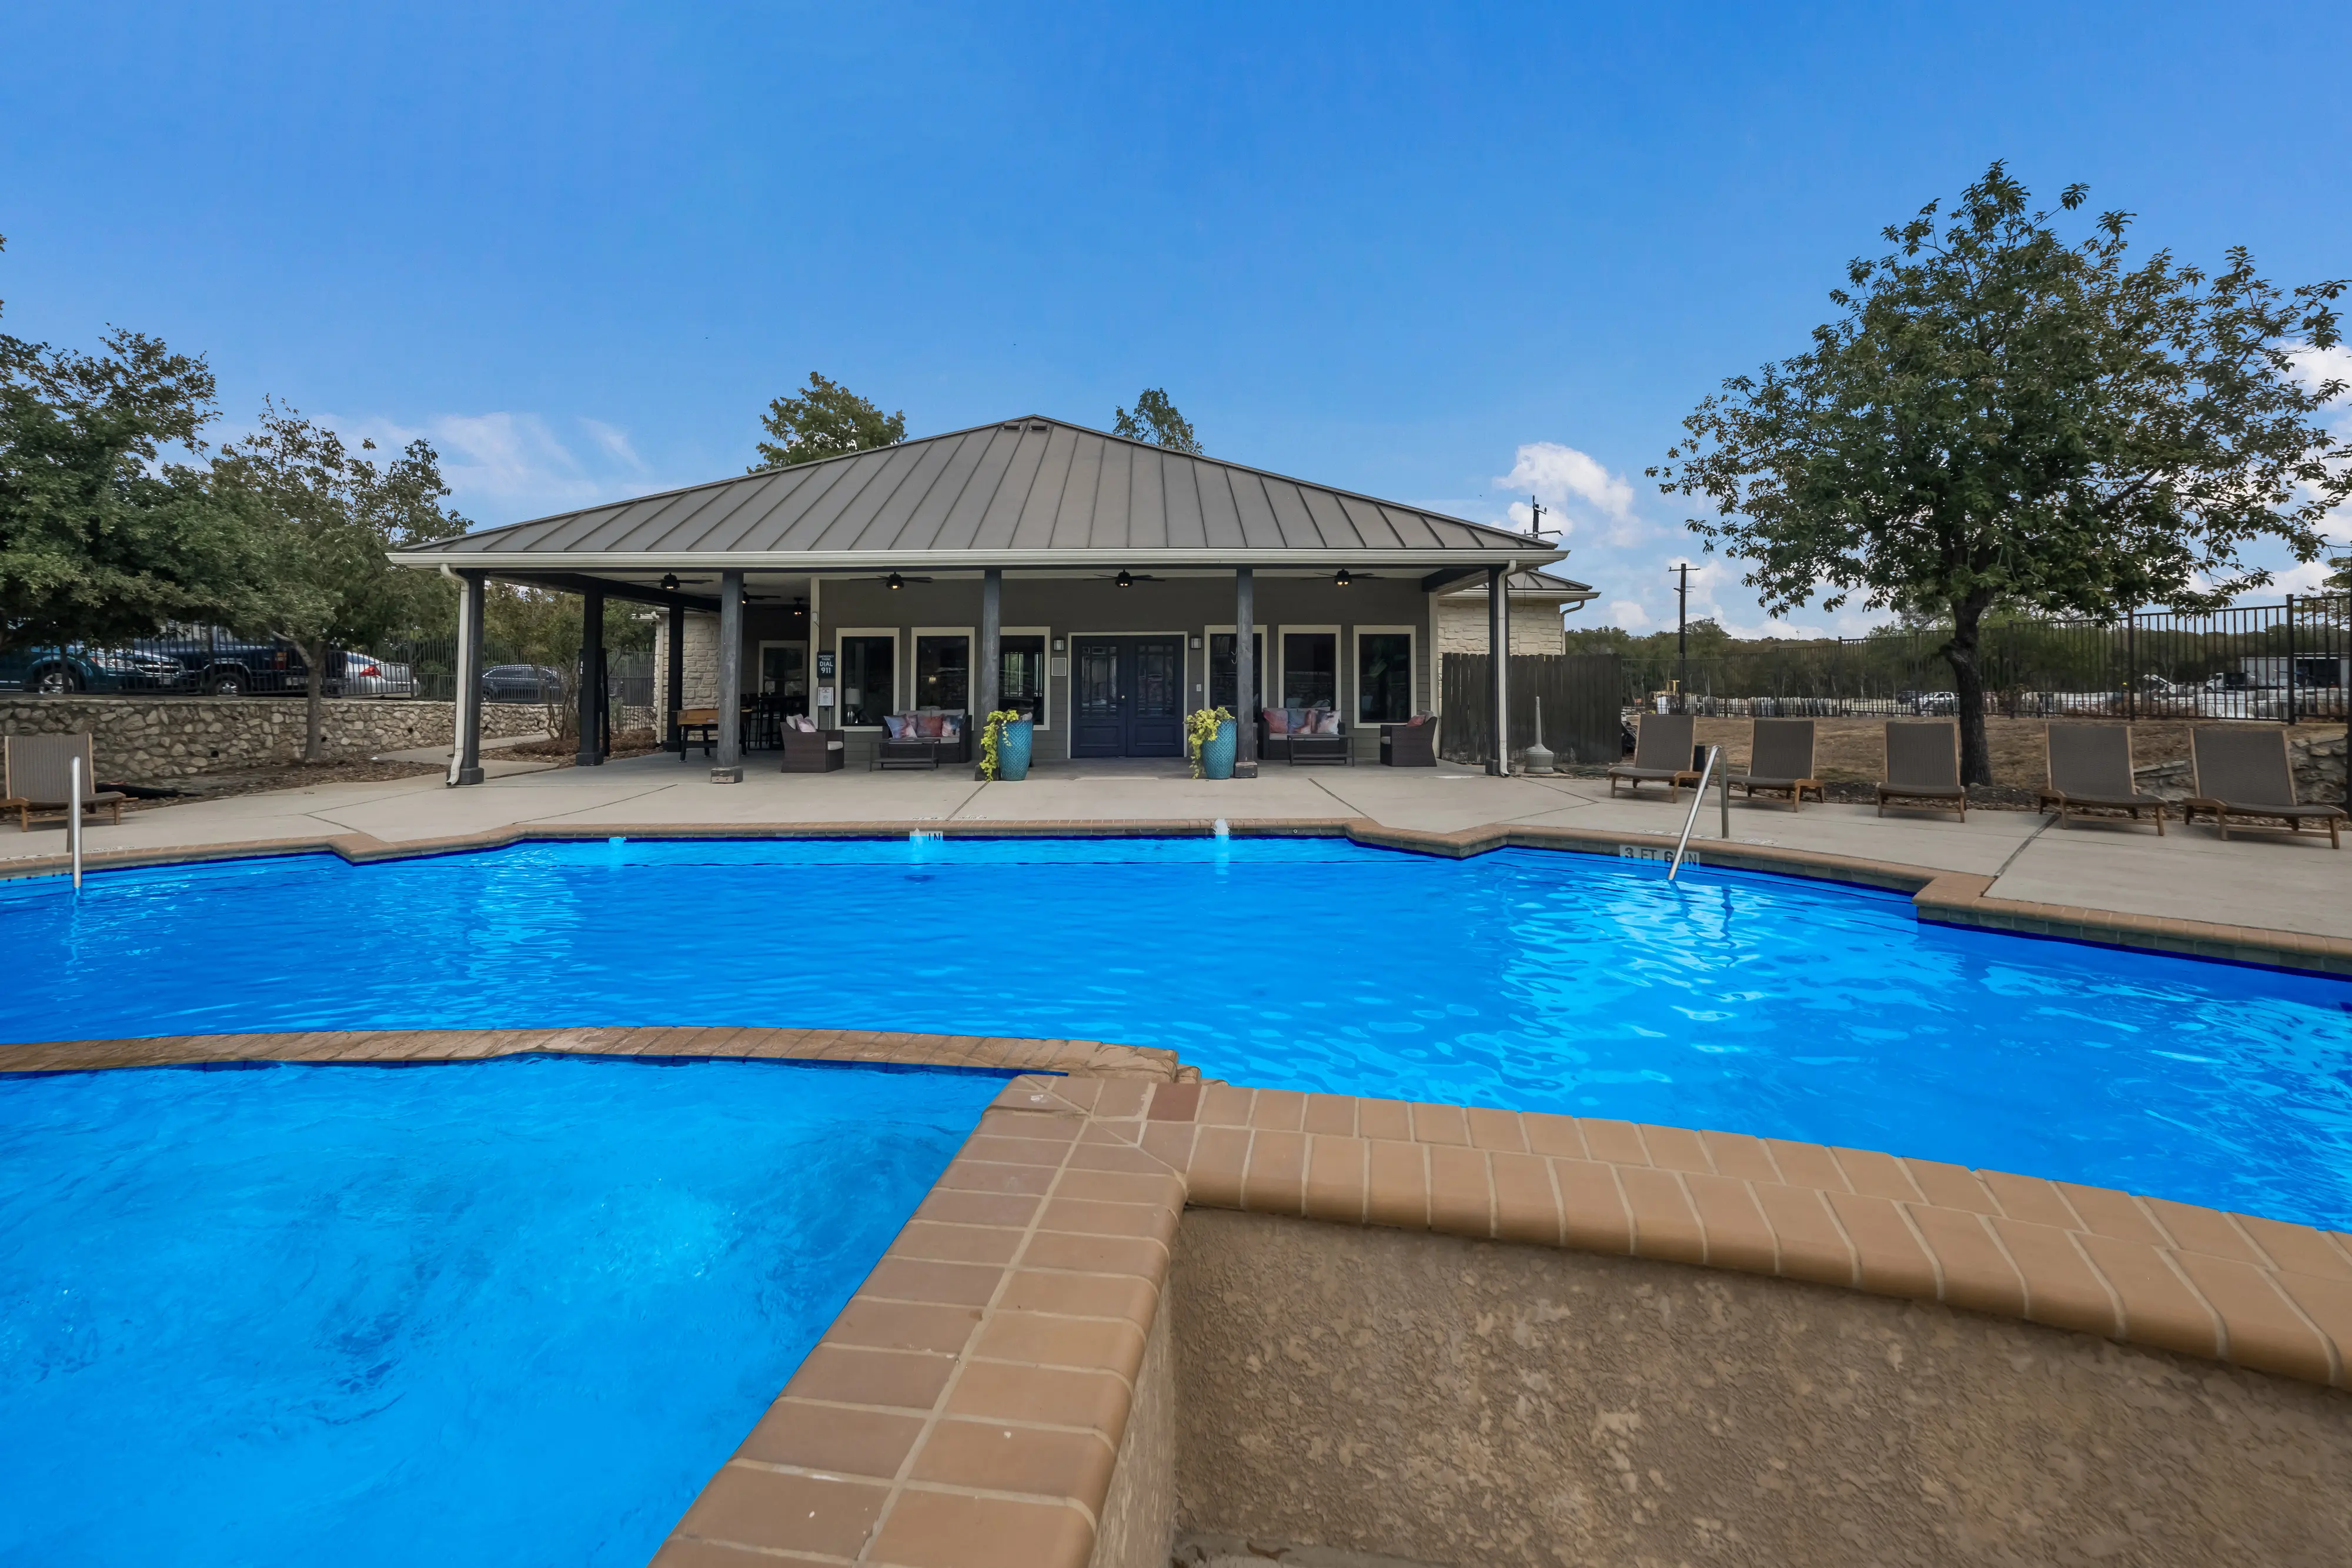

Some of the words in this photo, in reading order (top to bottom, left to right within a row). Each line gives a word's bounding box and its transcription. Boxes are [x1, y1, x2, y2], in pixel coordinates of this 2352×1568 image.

[928, 833, 940, 841] IN
[1625, 847, 1634, 858] 3
[1641, 848, 1657, 861] FT
[1664, 851, 1674, 863] 6
[1682, 852, 1697, 865] IN
